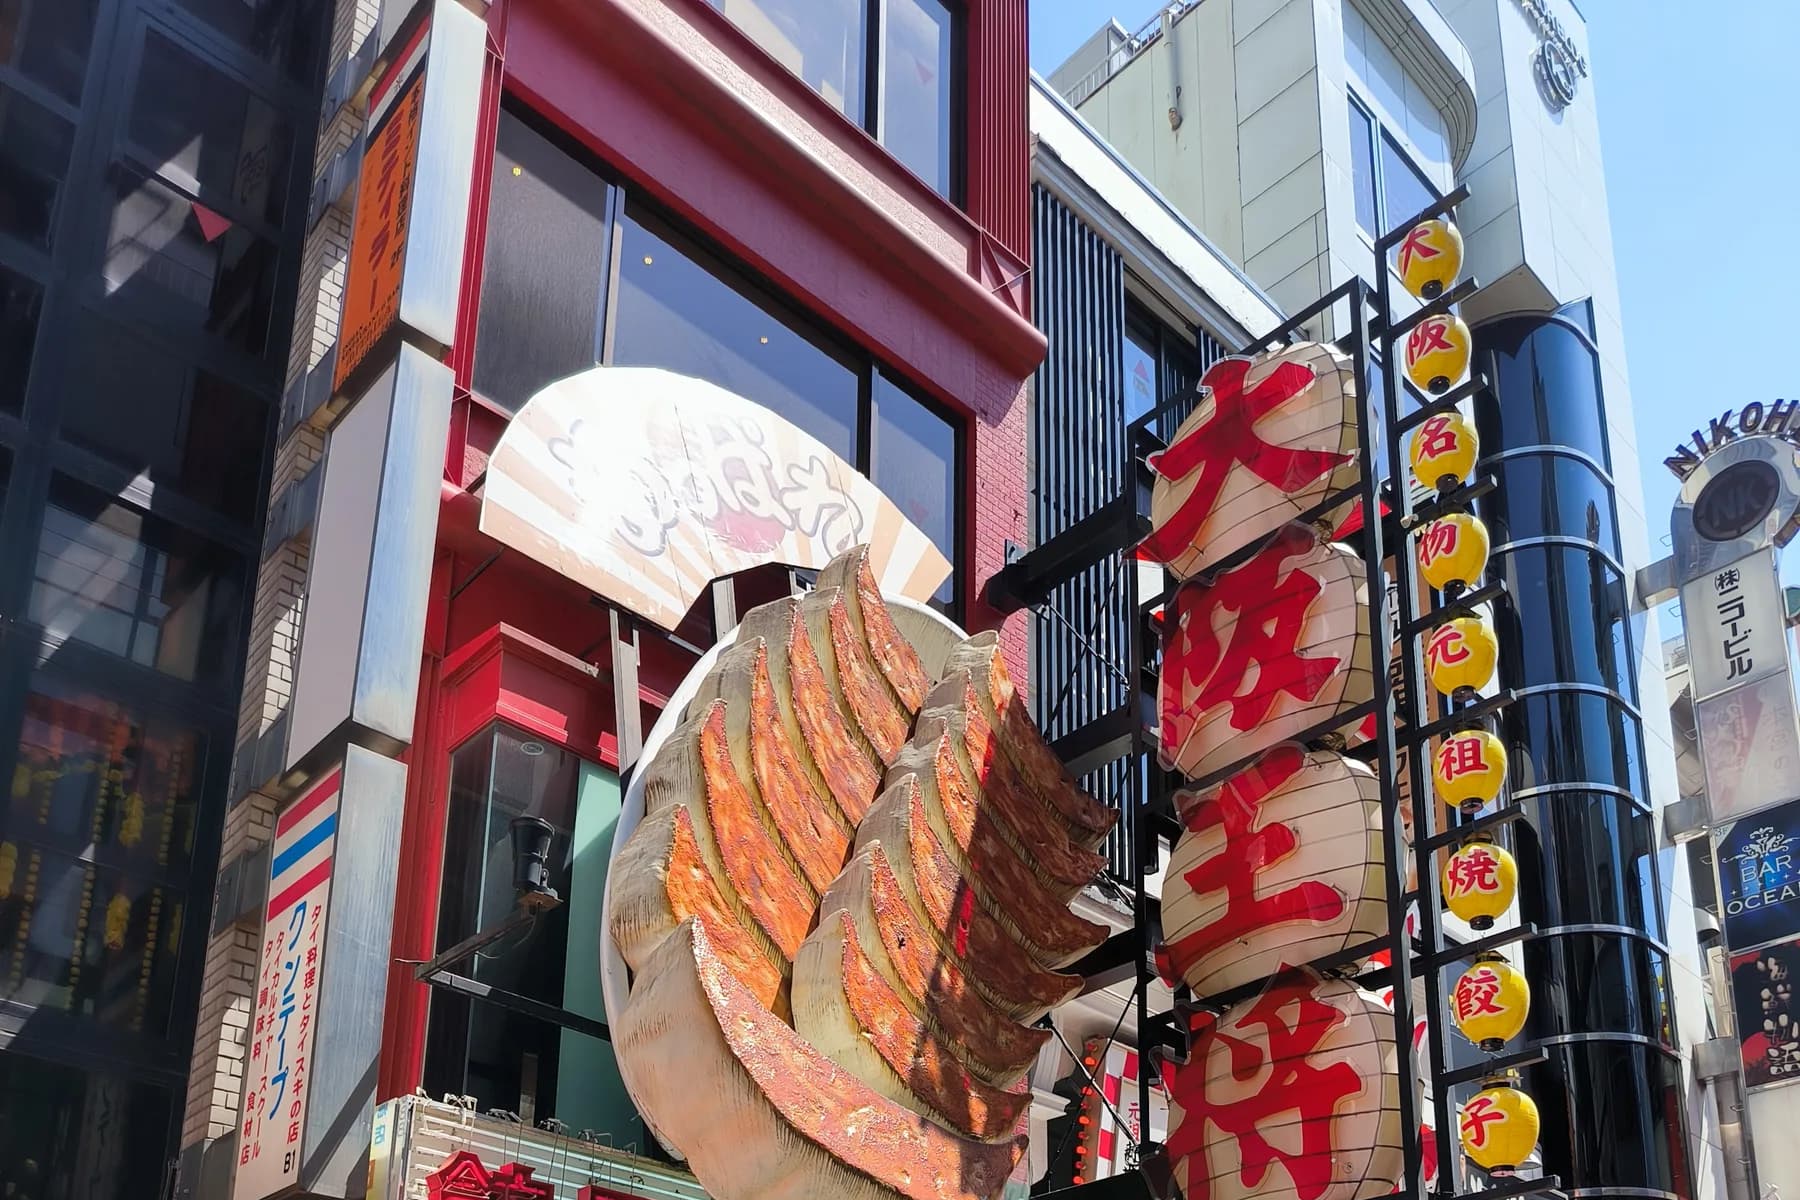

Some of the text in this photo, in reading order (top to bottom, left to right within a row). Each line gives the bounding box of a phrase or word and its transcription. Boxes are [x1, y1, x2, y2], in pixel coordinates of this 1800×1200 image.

[1727, 886, 1800, 916] OCEA
[1741, 855, 1792, 884] BAR
[251, 931, 285, 1161] タイカルチャースクール
[269, 900, 307, 1122] クンテープ
[288, 904, 323, 1145] タイ料理とタイスキの店
[283, 1156, 297, 1175] B1
